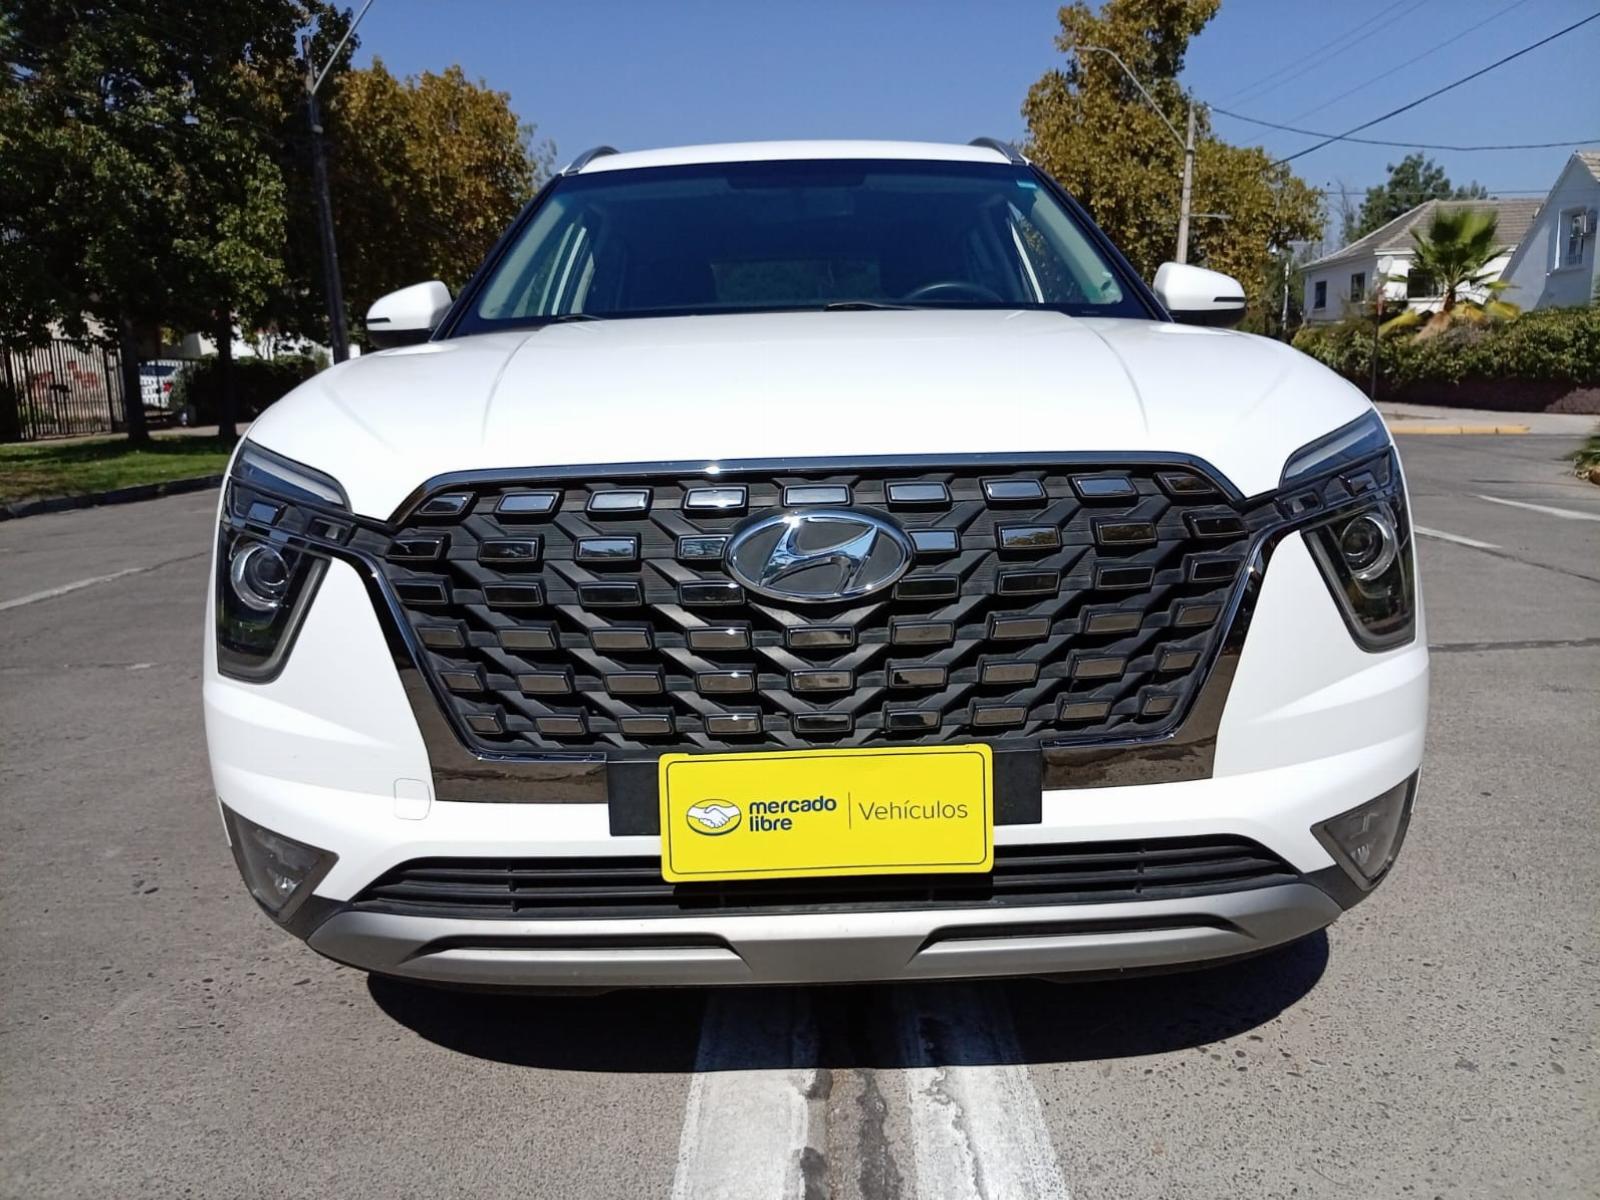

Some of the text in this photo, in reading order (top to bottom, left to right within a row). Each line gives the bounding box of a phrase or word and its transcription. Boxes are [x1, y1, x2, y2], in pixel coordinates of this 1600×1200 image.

[749, 795, 838, 815] mercado
[857, 799, 969, 821] Vehículos
[749, 815, 793, 832] libre
